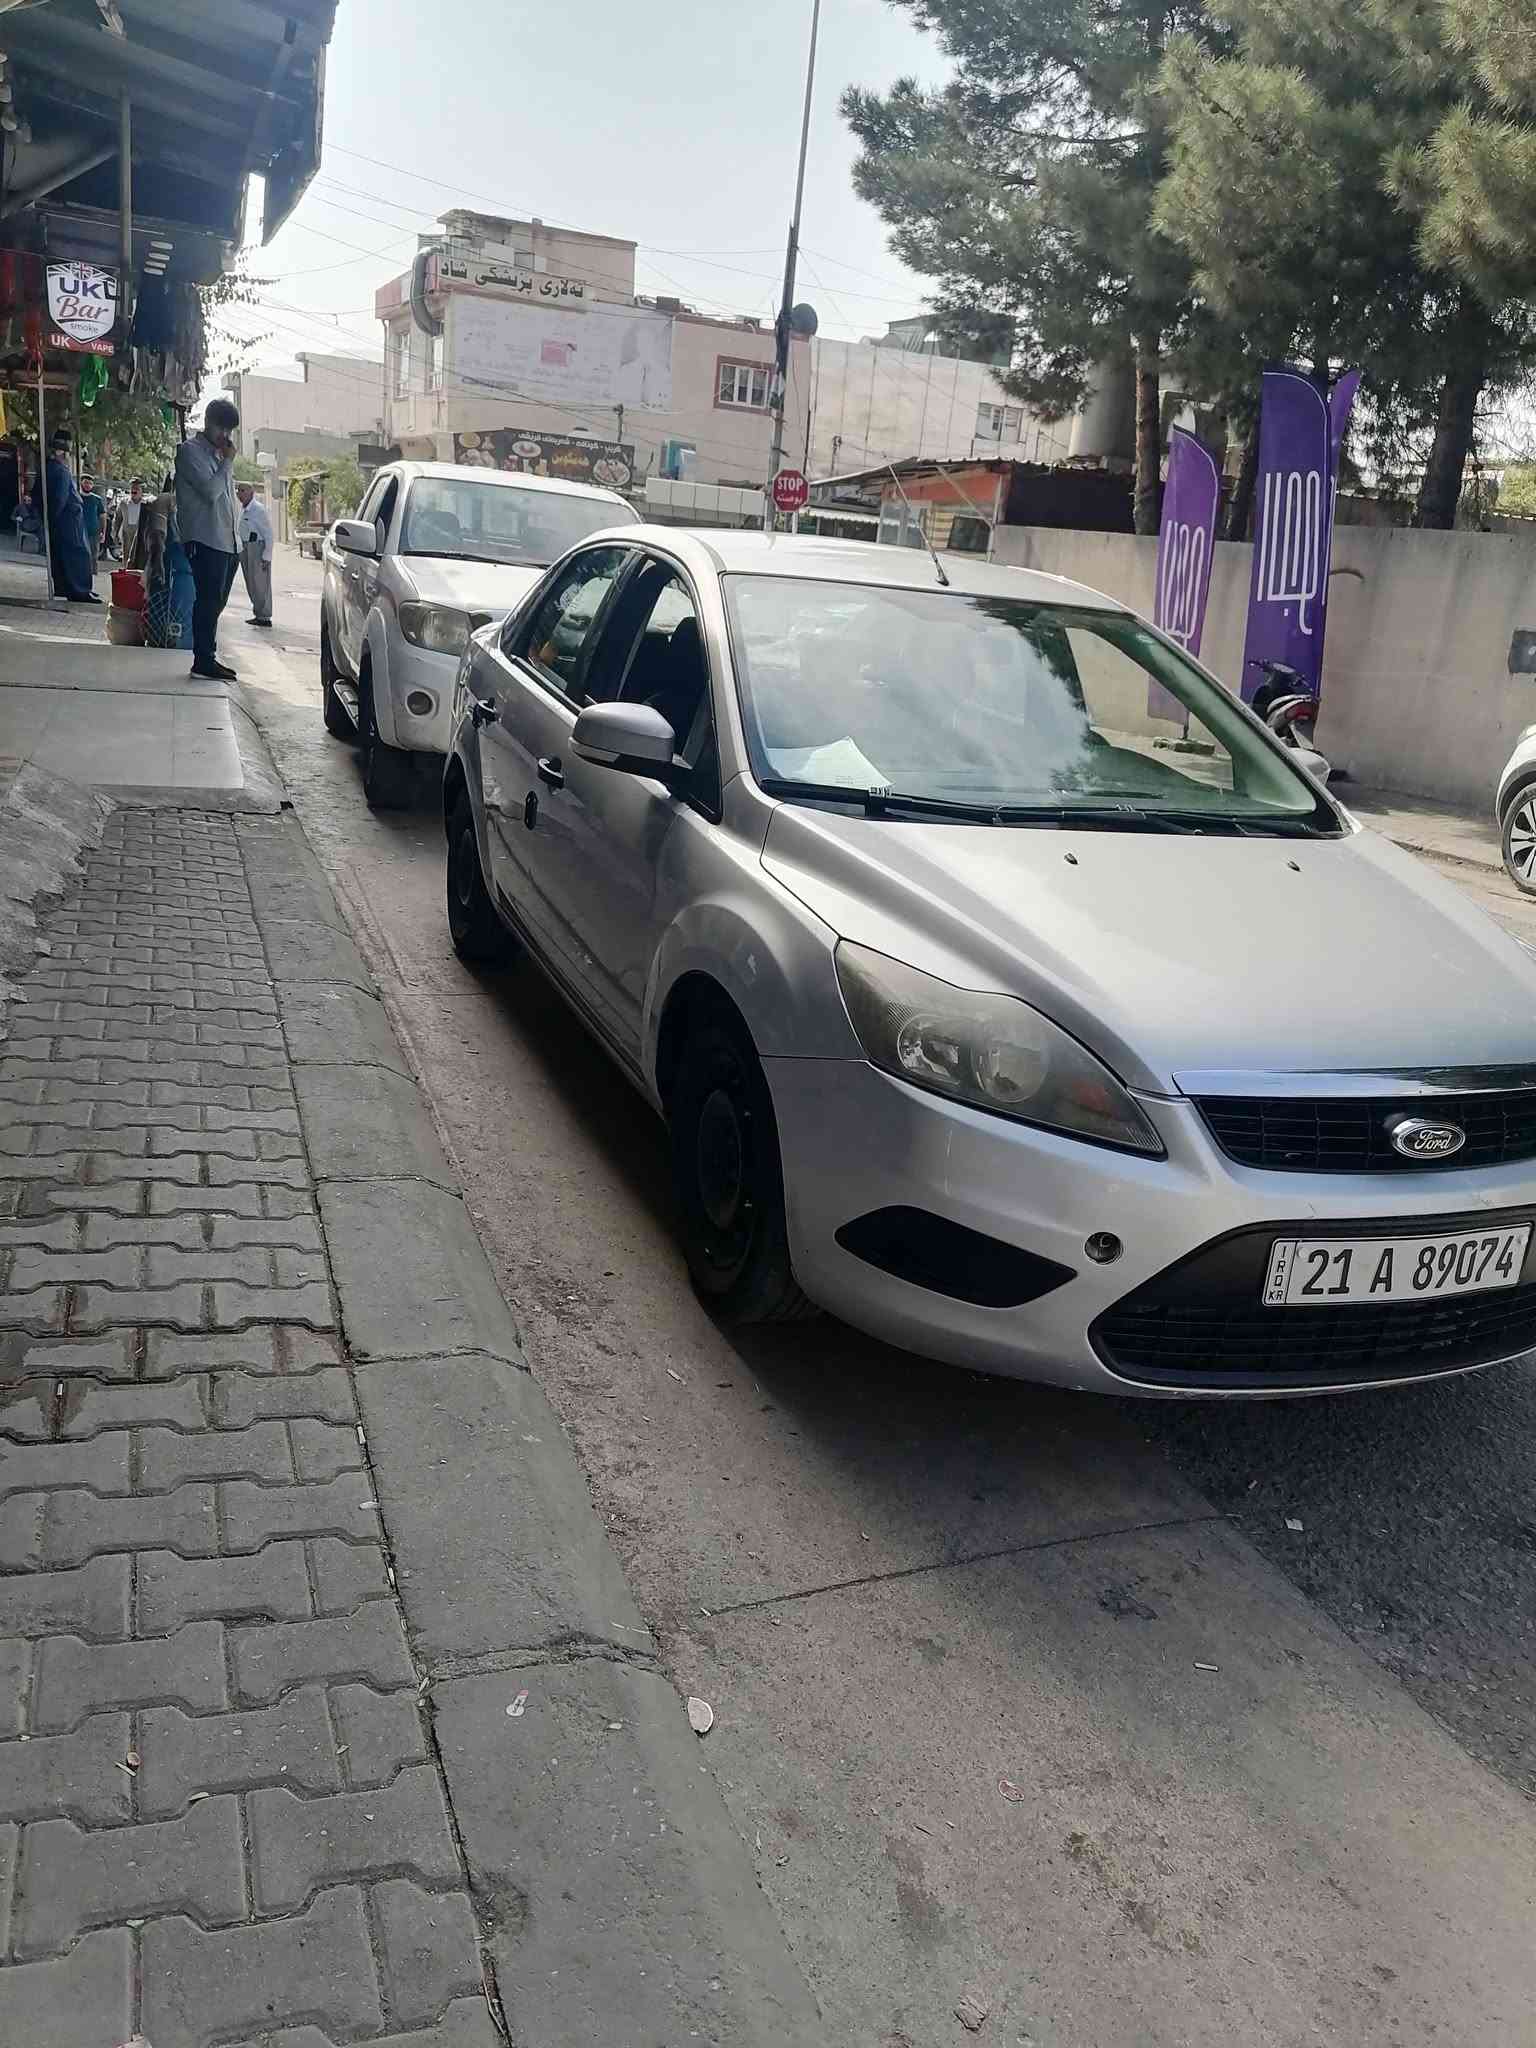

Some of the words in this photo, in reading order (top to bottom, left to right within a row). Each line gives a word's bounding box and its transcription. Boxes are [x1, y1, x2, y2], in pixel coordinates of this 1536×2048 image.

[440, 260, 468, 279] شاد
[59, 277, 102, 300] UK
[56, 295, 109, 319] Bar
[51, 334, 71, 348] UK
[91, 342, 115, 355] VAPE
[777, 476, 804, 491] STOP
[1414, 1129, 1453, 1150] Ford
[1301, 1248, 1353, 1296] 21
[1369, 1247, 1394, 1294] A
[1412, 1235, 1515, 1291] 89074
